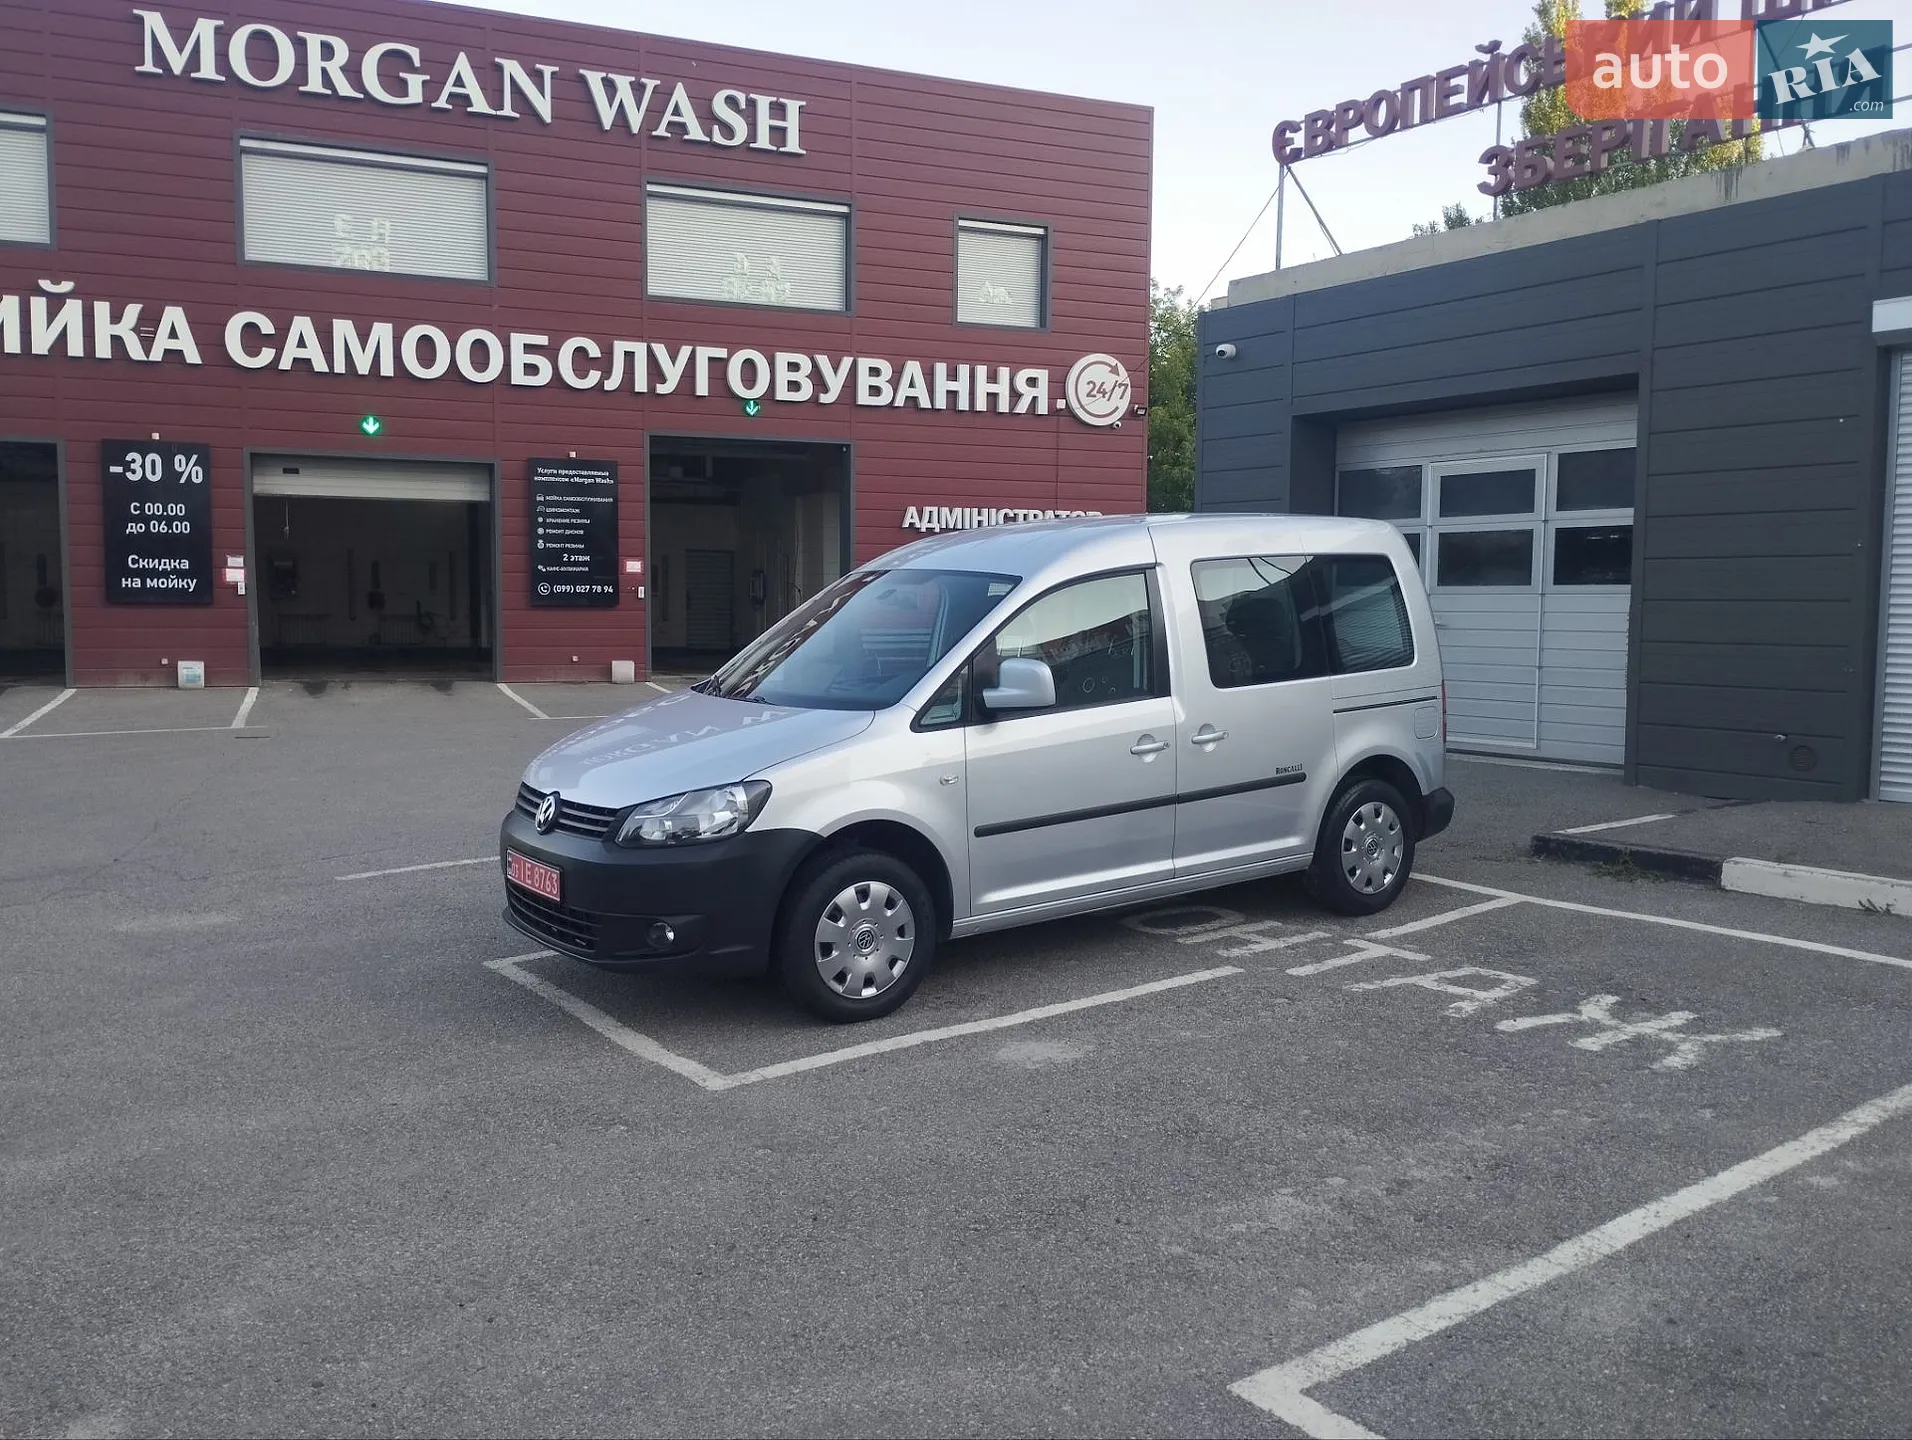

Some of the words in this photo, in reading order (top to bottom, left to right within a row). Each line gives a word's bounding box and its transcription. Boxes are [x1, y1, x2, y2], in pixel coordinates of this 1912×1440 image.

[132, 9, 559, 124] MORGAN
[579, 69, 807, 155] WASH
[224, 311, 1050, 416] САМООБСЛУГОВУВАННЯ
[1086, 380, 1129, 402] 24/7
[109, 452, 162, 482] -30
[174, 454, 203, 484] %
[130, 502, 141, 515] С
[145, 503, 185, 516] 00.00
[126, 522, 145, 535] до
[150, 521, 190, 534] 06.00
[902, 506, 1104, 533] АДМІНІСТРА
[128, 555, 189, 571] Скидка
[563, 553, 569, 561] 2
[121, 577, 141, 588] на
[146, 575, 197, 592] мойку
[553, 584, 574, 593] (099)
[575, 585, 590, 593] 027
[591, 585, 602, 593] 78
[603, 585, 614, 593] 94
[534, 867, 558, 894] 8763
